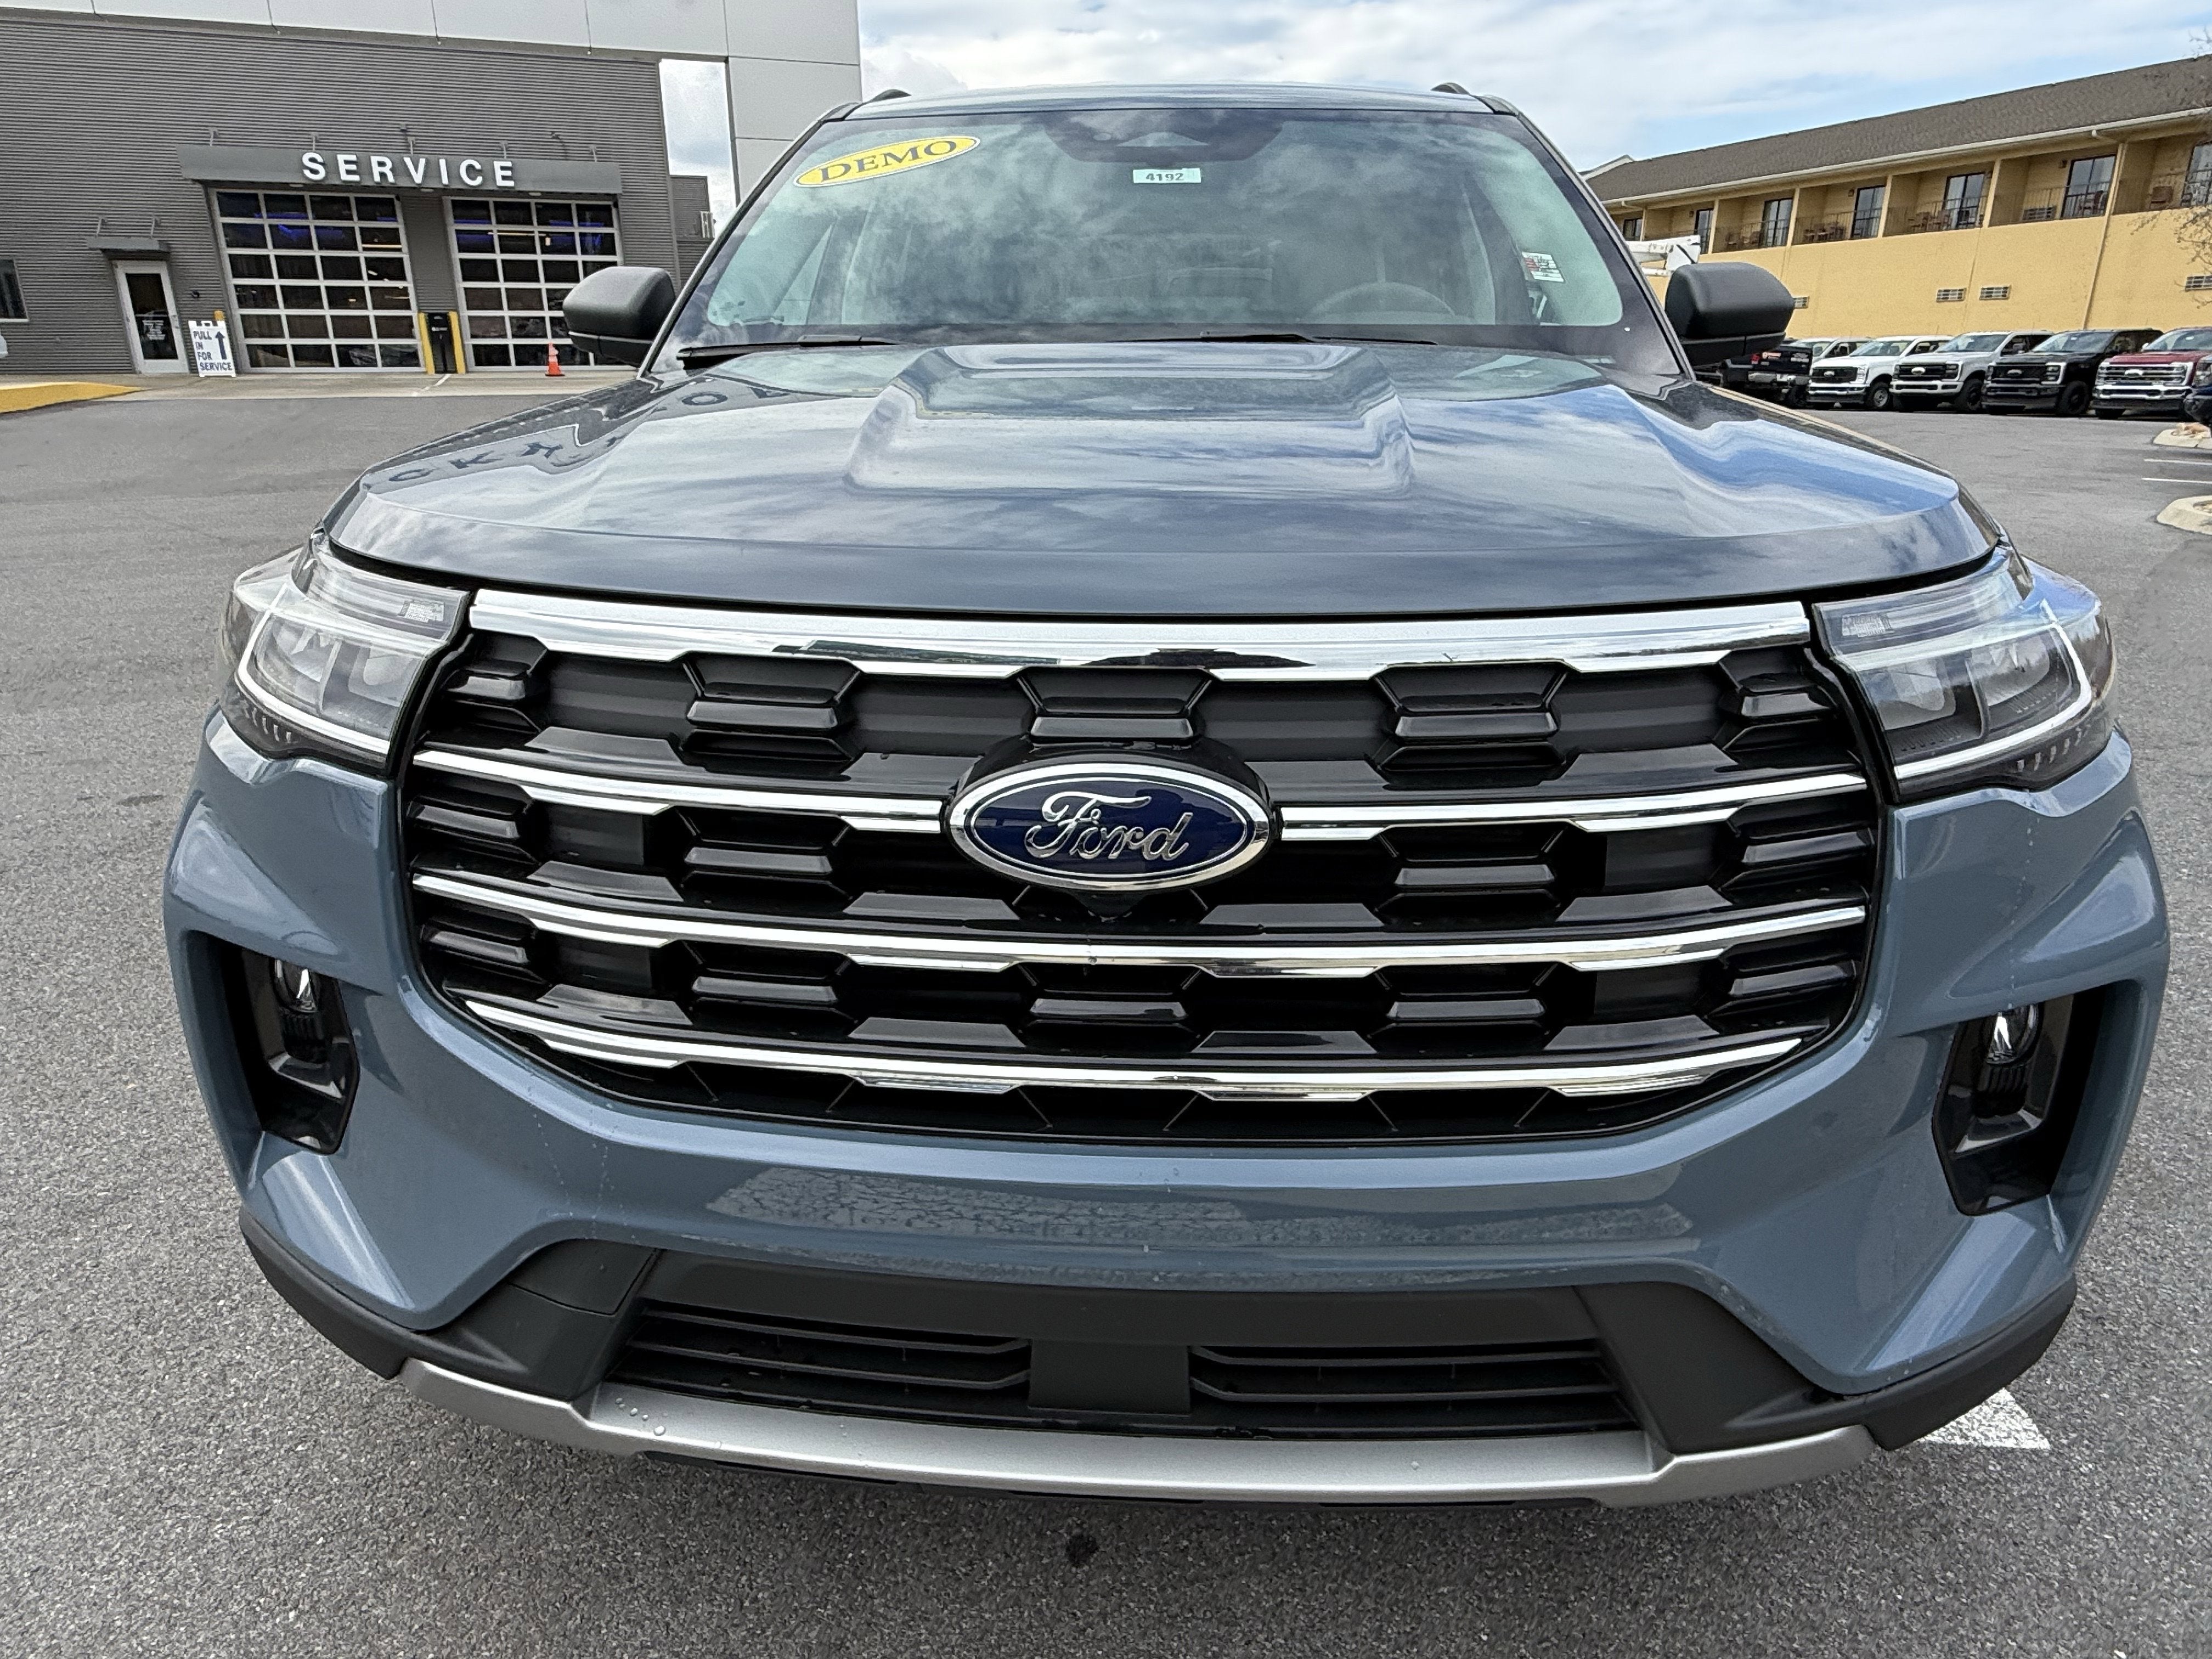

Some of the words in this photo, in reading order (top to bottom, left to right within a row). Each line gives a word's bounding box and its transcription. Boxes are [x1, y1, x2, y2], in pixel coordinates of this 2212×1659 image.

[819, 140, 957, 183] DEMO
[302, 152, 515, 187] SERVICE
[1146, 172, 1184, 182] 4192
[193, 330, 213, 340] PULL
[195, 341, 204, 350] IN
[196, 351, 213, 360] FOR
[200, 362, 233, 371] SERVICE
[1024, 791, 1194, 861] Ford
